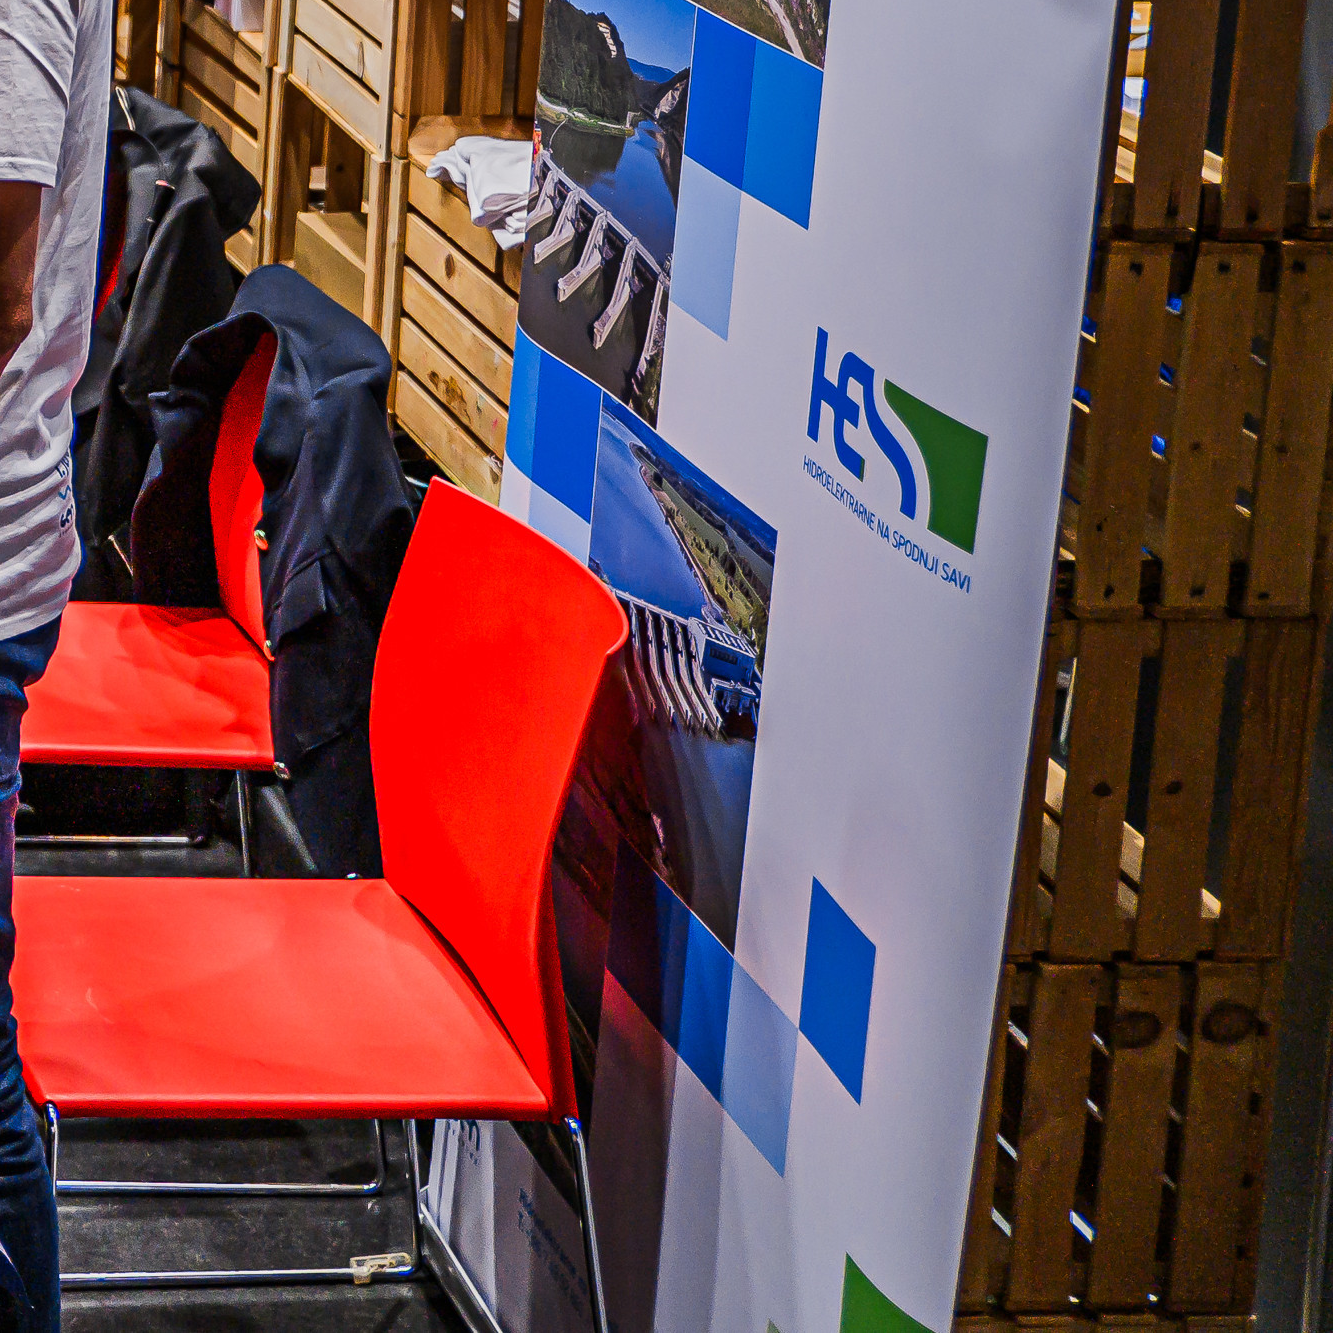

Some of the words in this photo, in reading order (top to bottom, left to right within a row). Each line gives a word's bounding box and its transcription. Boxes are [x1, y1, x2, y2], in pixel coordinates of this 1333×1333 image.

[802, 454, 876, 532] HIDROELEKTRARNE
[876, 519, 890, 543] NA
[891, 529, 940, 576] SPODNJI
[941, 562, 971, 594] SAVI
